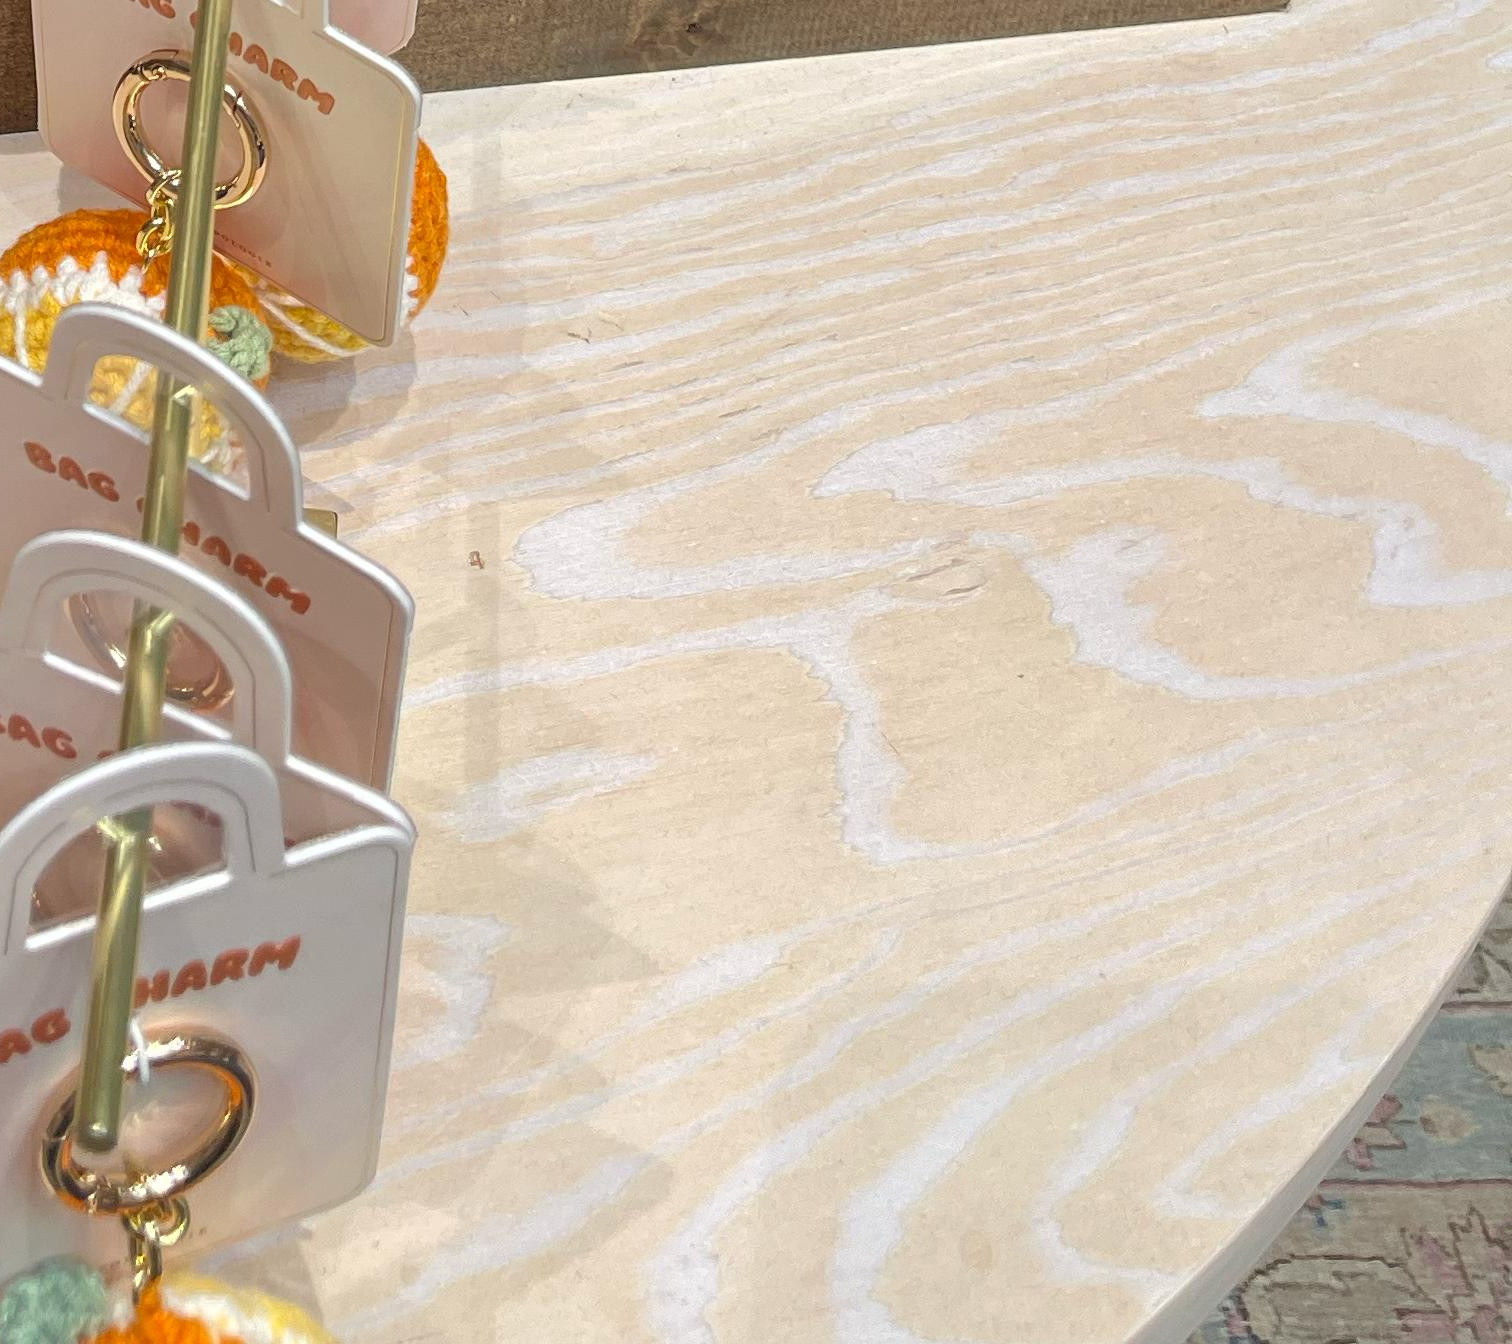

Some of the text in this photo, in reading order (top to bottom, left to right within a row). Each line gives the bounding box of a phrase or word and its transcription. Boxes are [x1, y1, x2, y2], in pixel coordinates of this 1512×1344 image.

[24, 441, 311, 615] BAG ARM
[134, 934, 301, 1009] HARM
